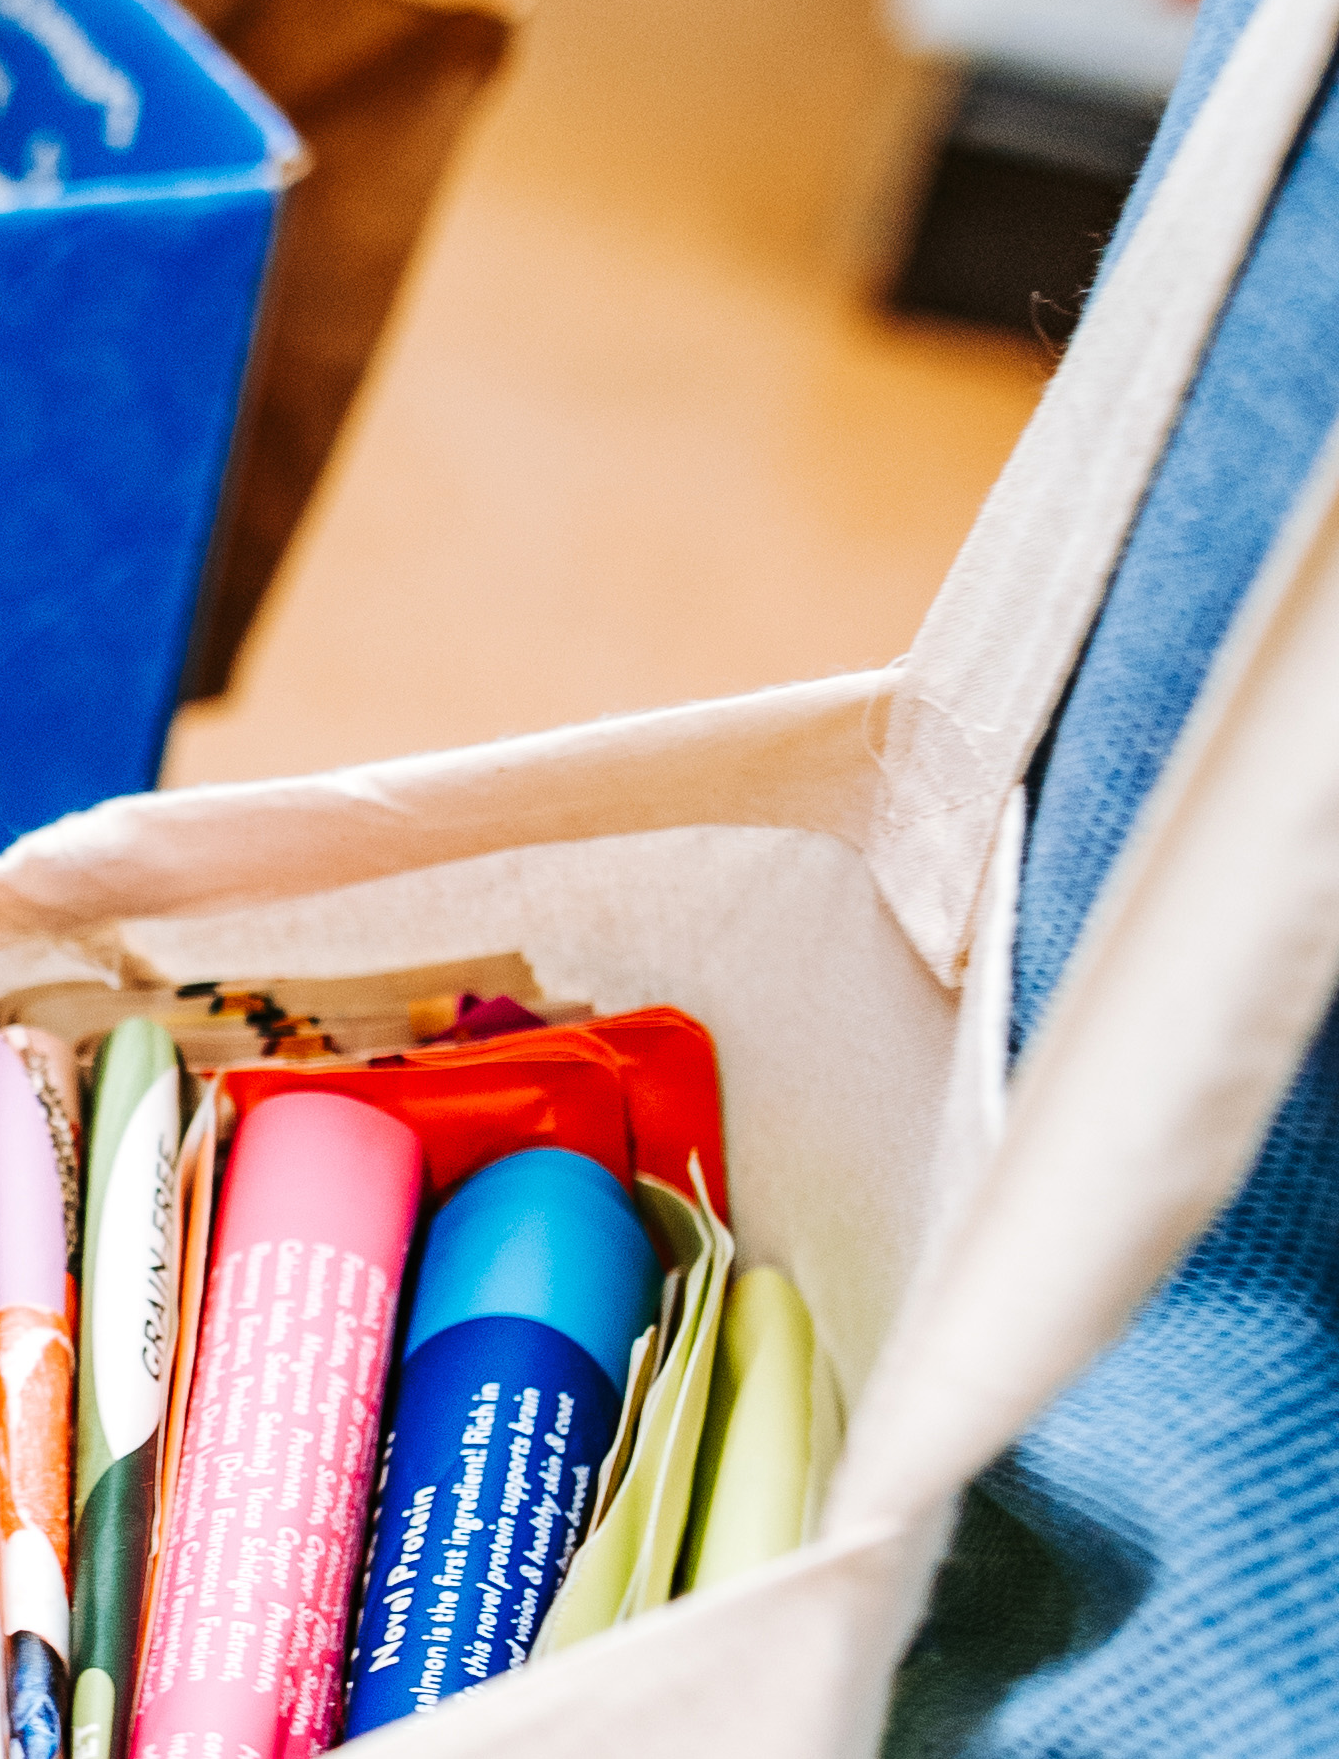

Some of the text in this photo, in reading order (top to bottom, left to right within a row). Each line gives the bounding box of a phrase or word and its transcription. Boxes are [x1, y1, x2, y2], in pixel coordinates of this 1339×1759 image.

[274, 1239, 303, 1295] Calcium
[261, 1351, 290, 1405] Sodium
[471, 1382, 500, 1402] in
[223, 1375, 256, 1445] Probiotics
[317, 1373, 349, 1460] Manganese
[461, 1403, 497, 1445] Rich
[507, 1387, 541, 1436] brain
[554, 1391, 575, 1436] coat
[251, 1244, 337, 1694] Proteinate, Manganese Proteinate, Copper Proteinate,
[544, 1432, 566, 1454] &
[441, 1449, 488, 1546] ingredient!
[500, 1436, 532, 1516] supports
[537, 1455, 563, 1495] skin
[244, 1486, 274, 1529] Yucca
[523, 1494, 561, 1566] healthy
[199, 1507, 238, 1608] Enterococcus
[386, 1486, 437, 1587] Protein
[487, 1517, 516, 1589] protein
[298, 1534, 327, 1599] Copper
[432, 1549, 468, 1587] first
[519, 1565, 543, 1586] &
[368, 1587, 415, 1673] Novel
[421, 1627, 452, 1642] is
[426, 1591, 459, 1623] the
[475, 1583, 503, 1639] novel
[510, 1588, 539, 1643] vision
[187, 1615, 223, 1682] Faecium
[215, 1621, 257, 1682] Extract,
[460, 1641, 493, 1678] this
